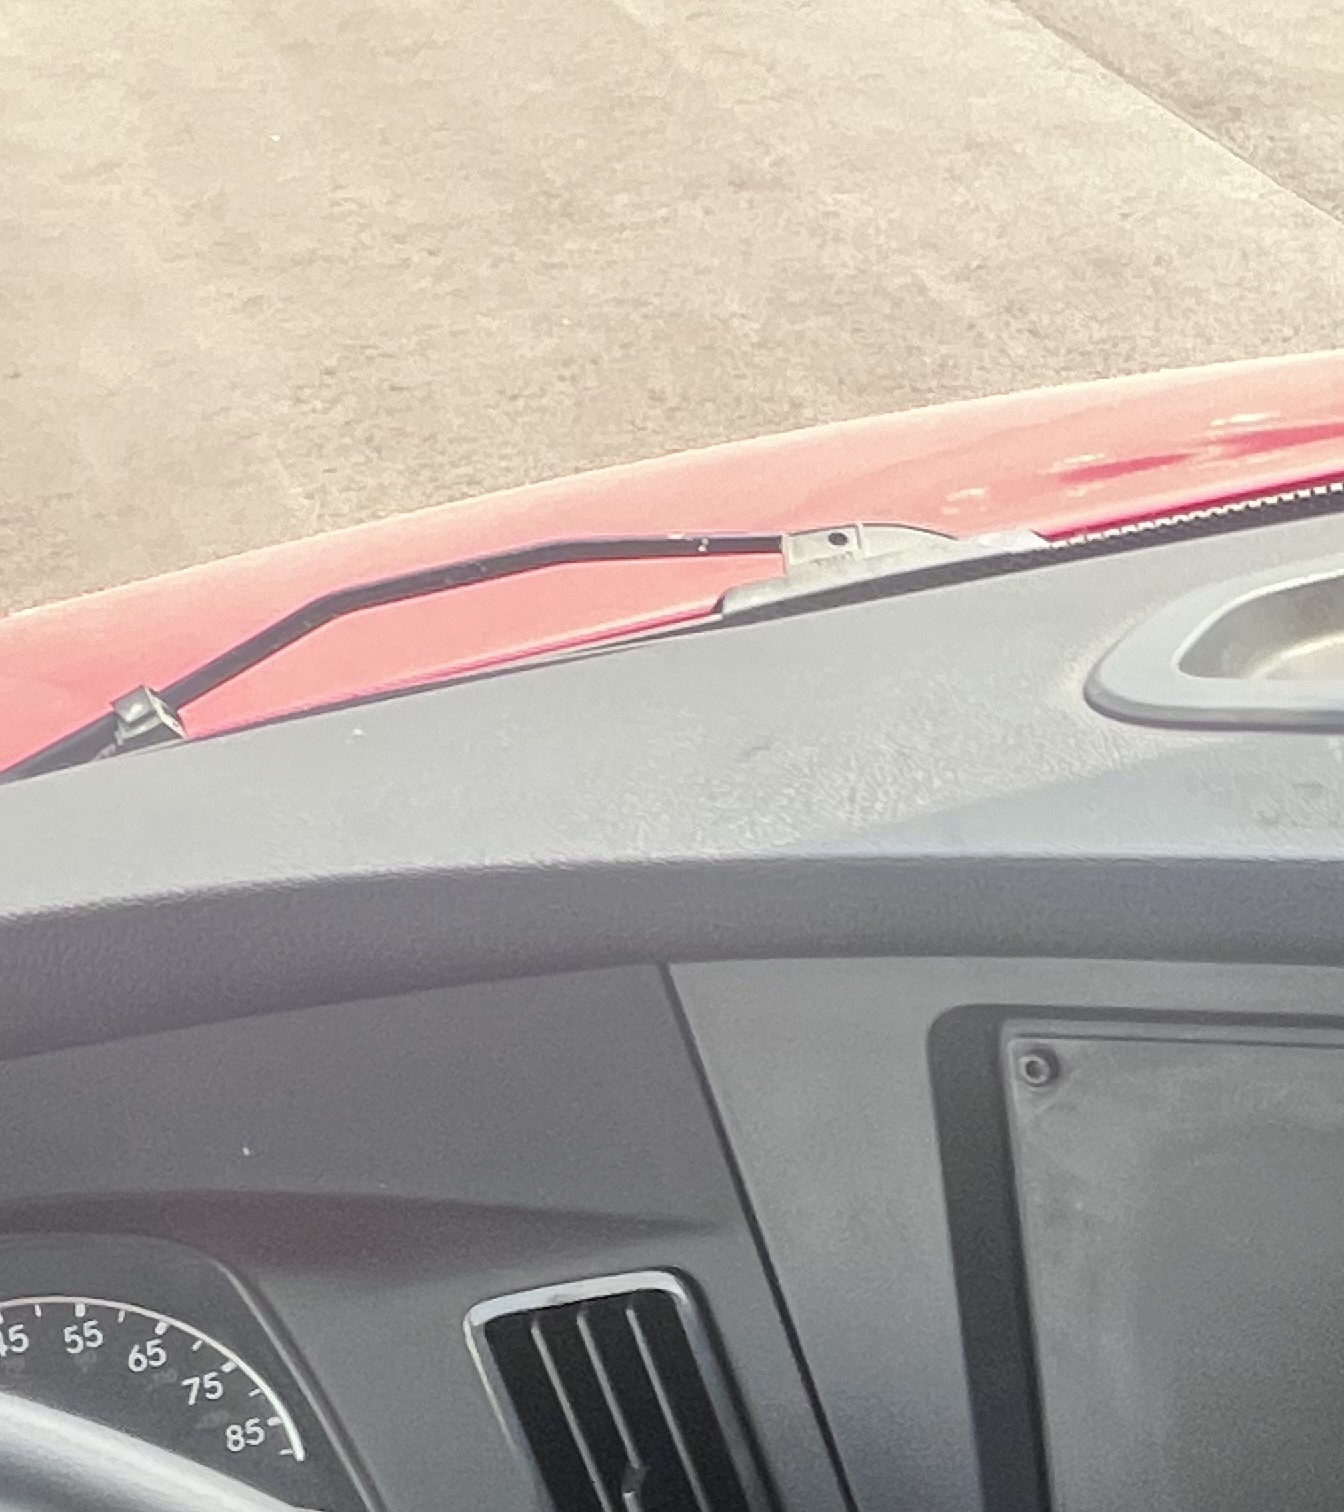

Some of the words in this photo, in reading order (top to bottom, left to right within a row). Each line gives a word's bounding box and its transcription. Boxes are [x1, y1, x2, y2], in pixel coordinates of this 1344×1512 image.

[63, 1319, 104, 1354] 55
[127, 1339, 167, 1372] 65
[181, 1371, 224, 1406] 75
[225, 1418, 265, 1452] 85
